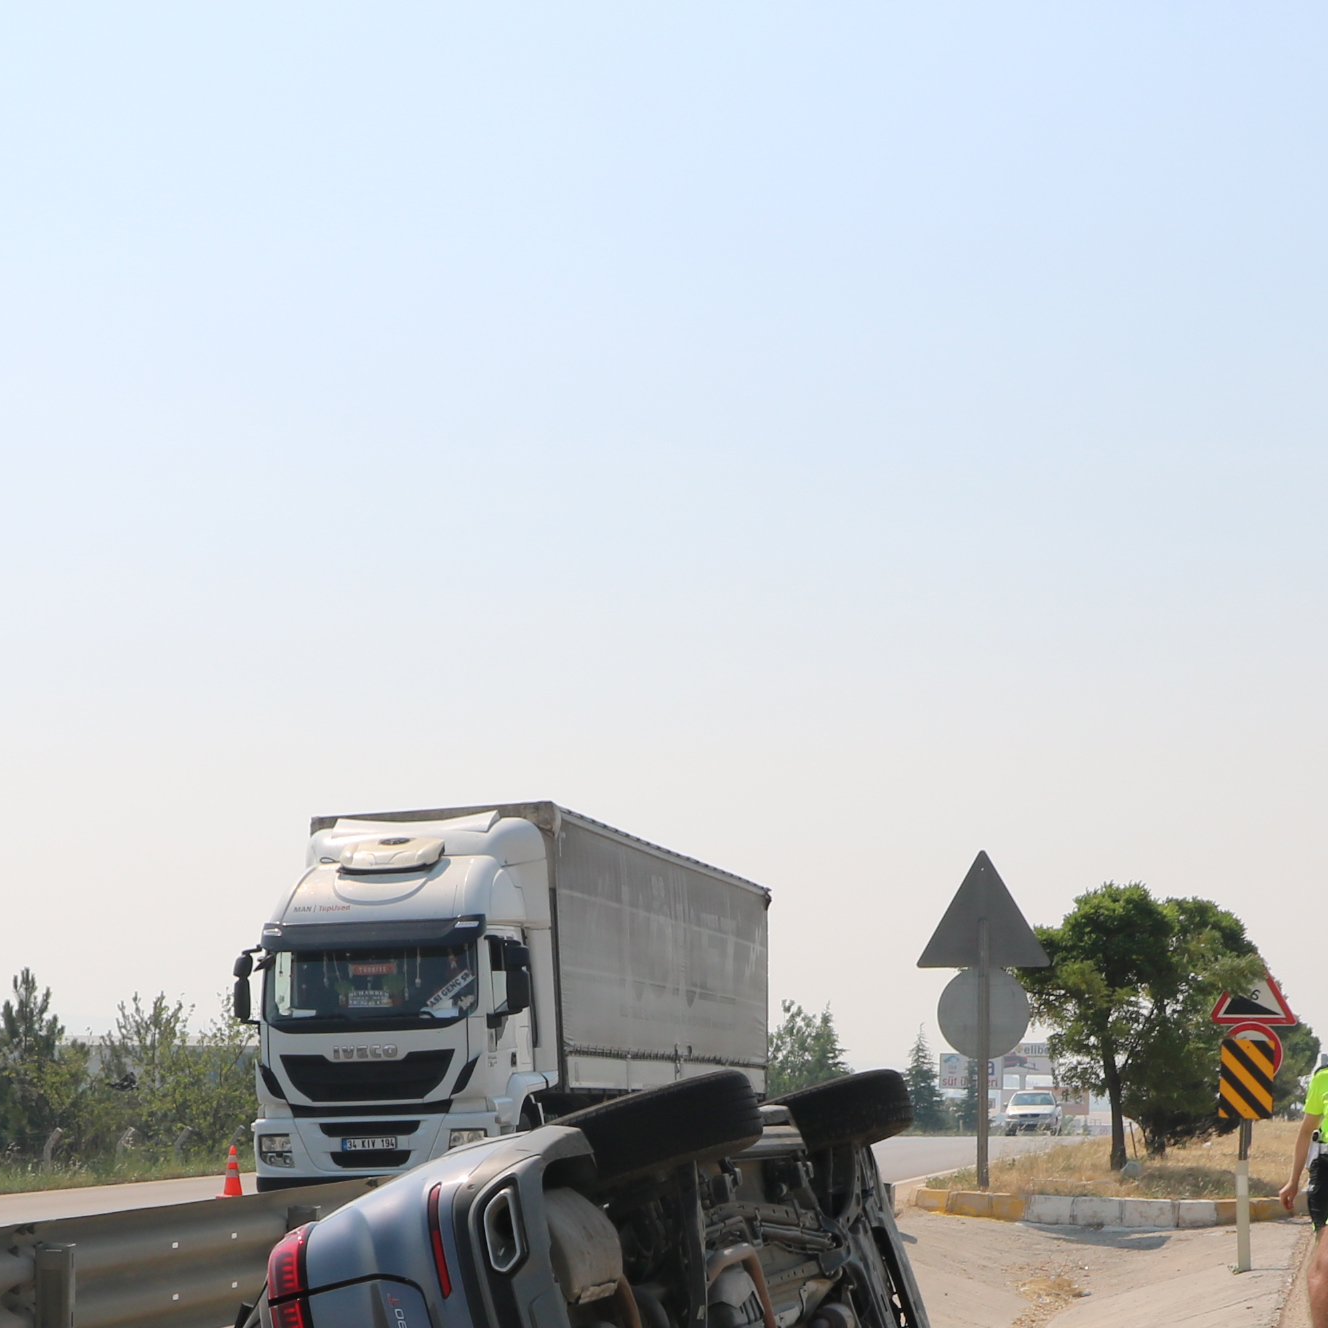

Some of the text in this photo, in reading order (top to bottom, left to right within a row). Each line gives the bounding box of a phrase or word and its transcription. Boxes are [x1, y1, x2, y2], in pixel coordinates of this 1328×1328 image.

[293, 905, 312, 913] MAN
[333, 1044, 398, 1060] IVECO
[347, 1138, 395, 1150] 34 KIV 194
